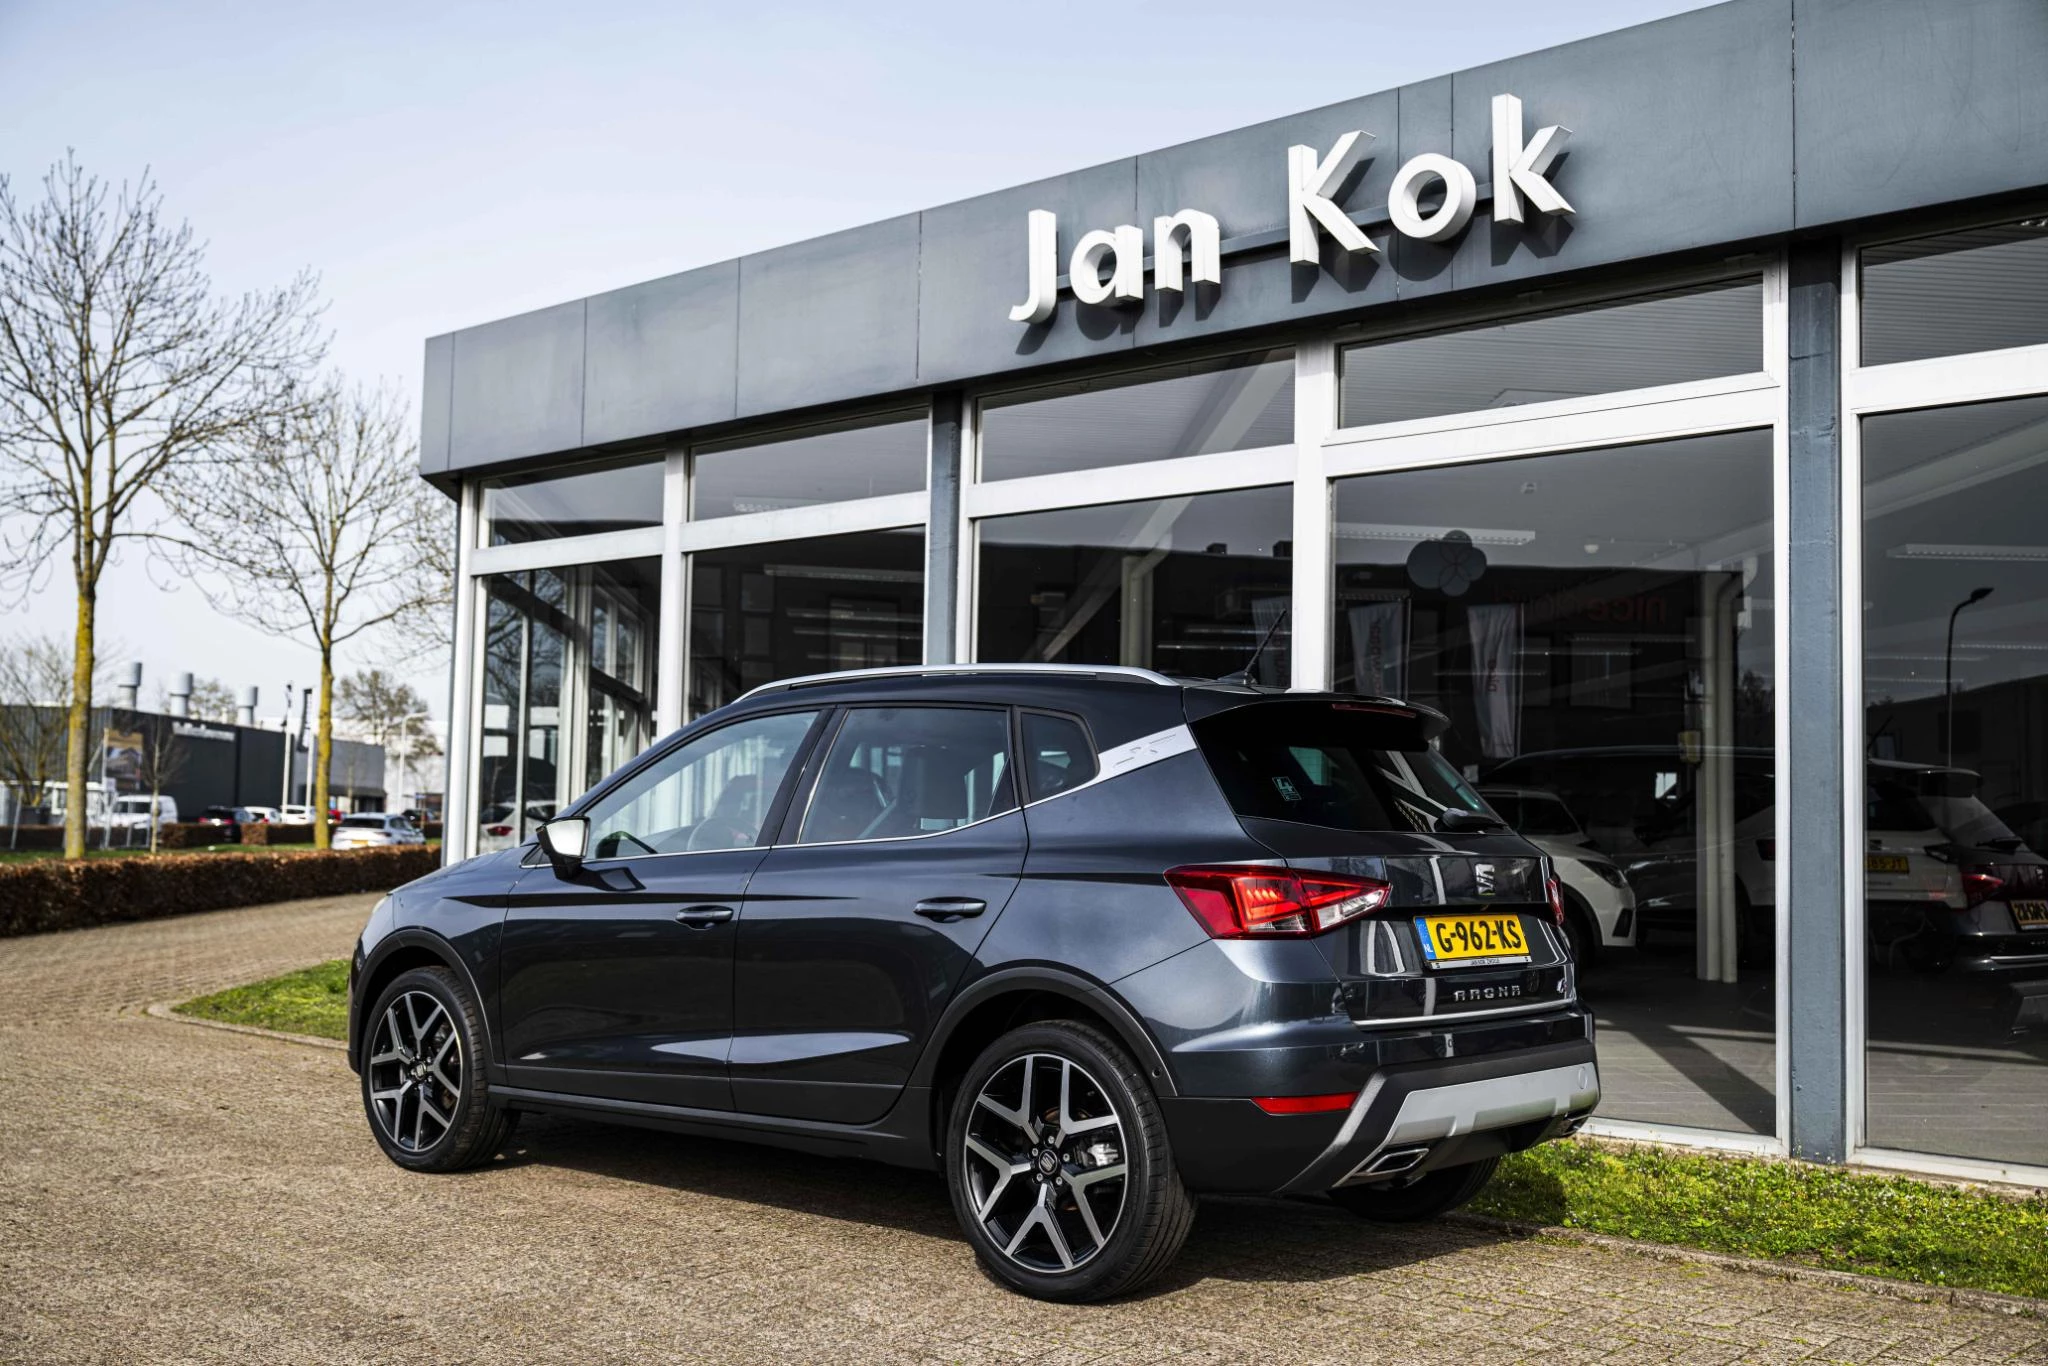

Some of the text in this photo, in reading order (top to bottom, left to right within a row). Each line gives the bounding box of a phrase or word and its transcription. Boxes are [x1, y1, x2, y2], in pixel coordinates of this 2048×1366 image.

[1008, 93, 1576, 325] Jan Kok
[1424, 944, 1434, 953] NL
[1436, 920, 1522, 953] G-962-KS
[1454, 985, 1521, 1001] ARONA
